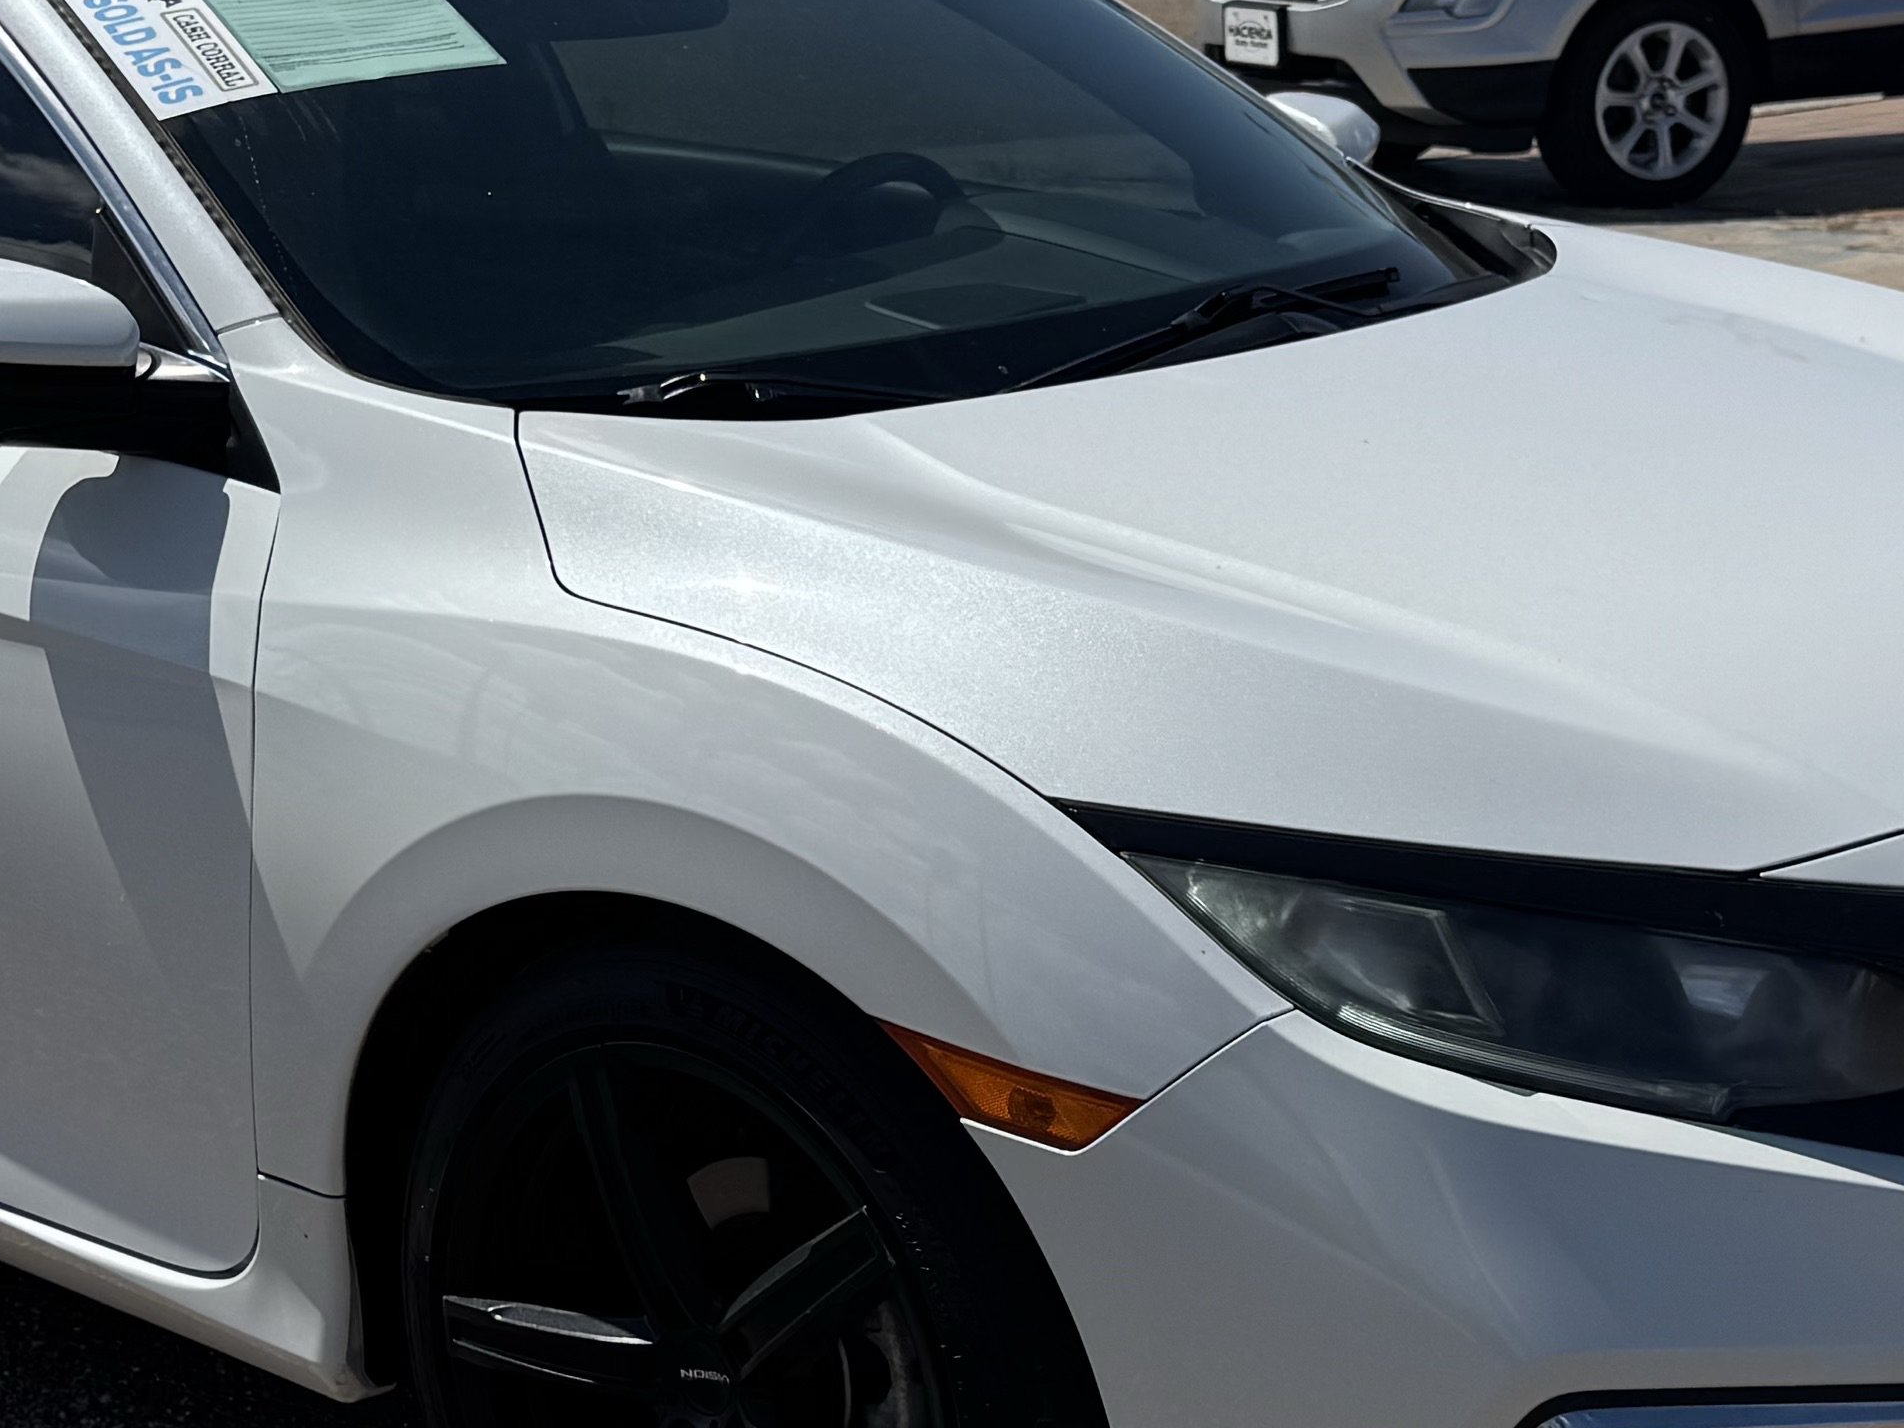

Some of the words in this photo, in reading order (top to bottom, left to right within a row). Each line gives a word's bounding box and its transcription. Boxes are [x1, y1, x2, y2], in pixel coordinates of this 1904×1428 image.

[124, 46, 204, 106] AS-IS
[172, 14, 212, 43] CASH
[195, 41, 246, 87] CORRAL
